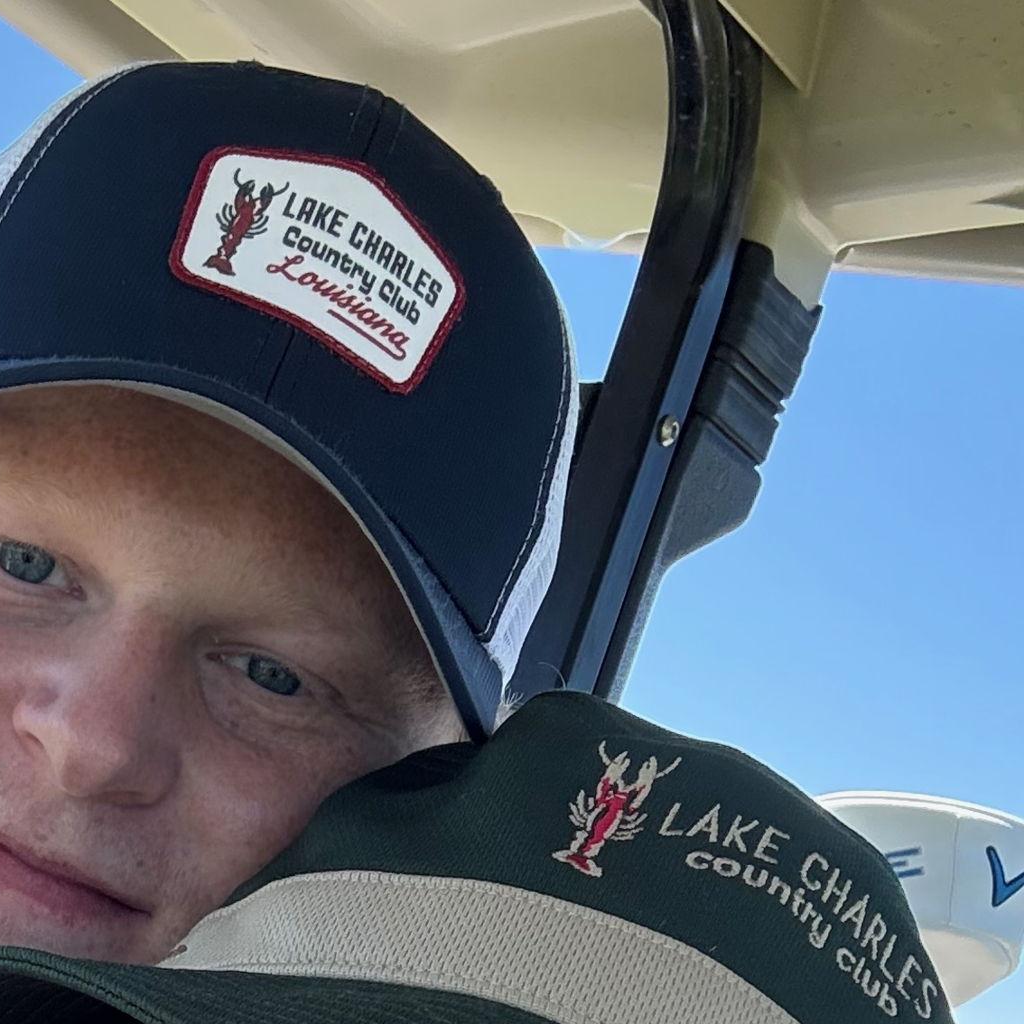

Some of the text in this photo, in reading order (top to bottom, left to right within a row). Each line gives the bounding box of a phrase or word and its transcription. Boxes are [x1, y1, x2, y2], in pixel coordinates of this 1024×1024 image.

[266, 254, 410, 349] Louisiana
[282, 192, 443, 308] LAKE CHARLES
[282, 226, 422, 326] Country Club
[659, 801, 939, 1020] LAKE CHARLES
